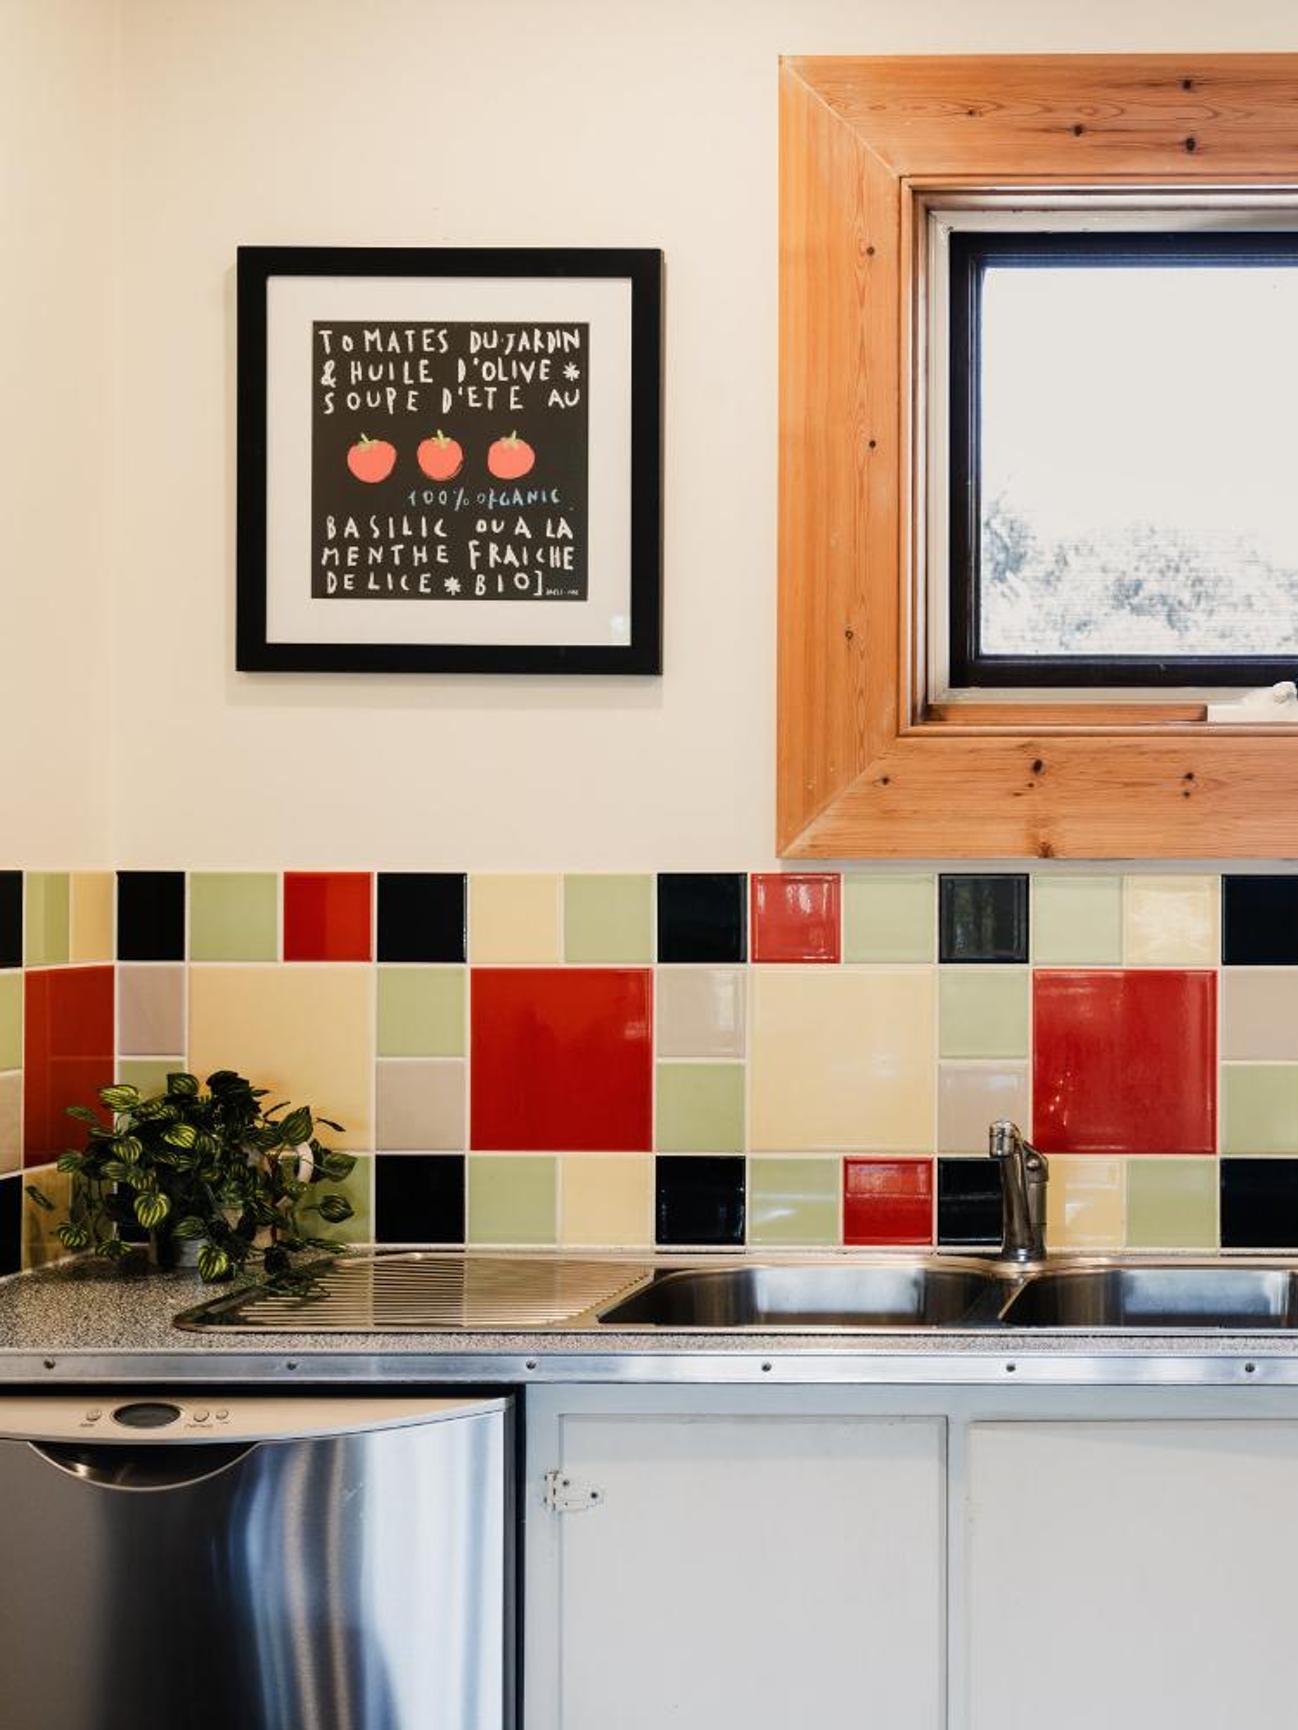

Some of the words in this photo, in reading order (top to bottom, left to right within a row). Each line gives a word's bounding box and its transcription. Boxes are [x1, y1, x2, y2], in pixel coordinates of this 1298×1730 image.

[319, 329, 449, 354] TOMATES
[321, 359, 336, 387] &
[350, 359, 433, 385] HUILE
[458, 357, 550, 384] D'OLIVE
[323, 387, 419, 414] SOUPE
[548, 388, 580, 408] AU
[408, 487, 469, 511] 100%
[326, 515, 447, 539] BASILIC
[321, 545, 449, 566] MENTHE
[469, 540, 574, 570] FRAICHE
[326, 572, 431, 594] DELICE
